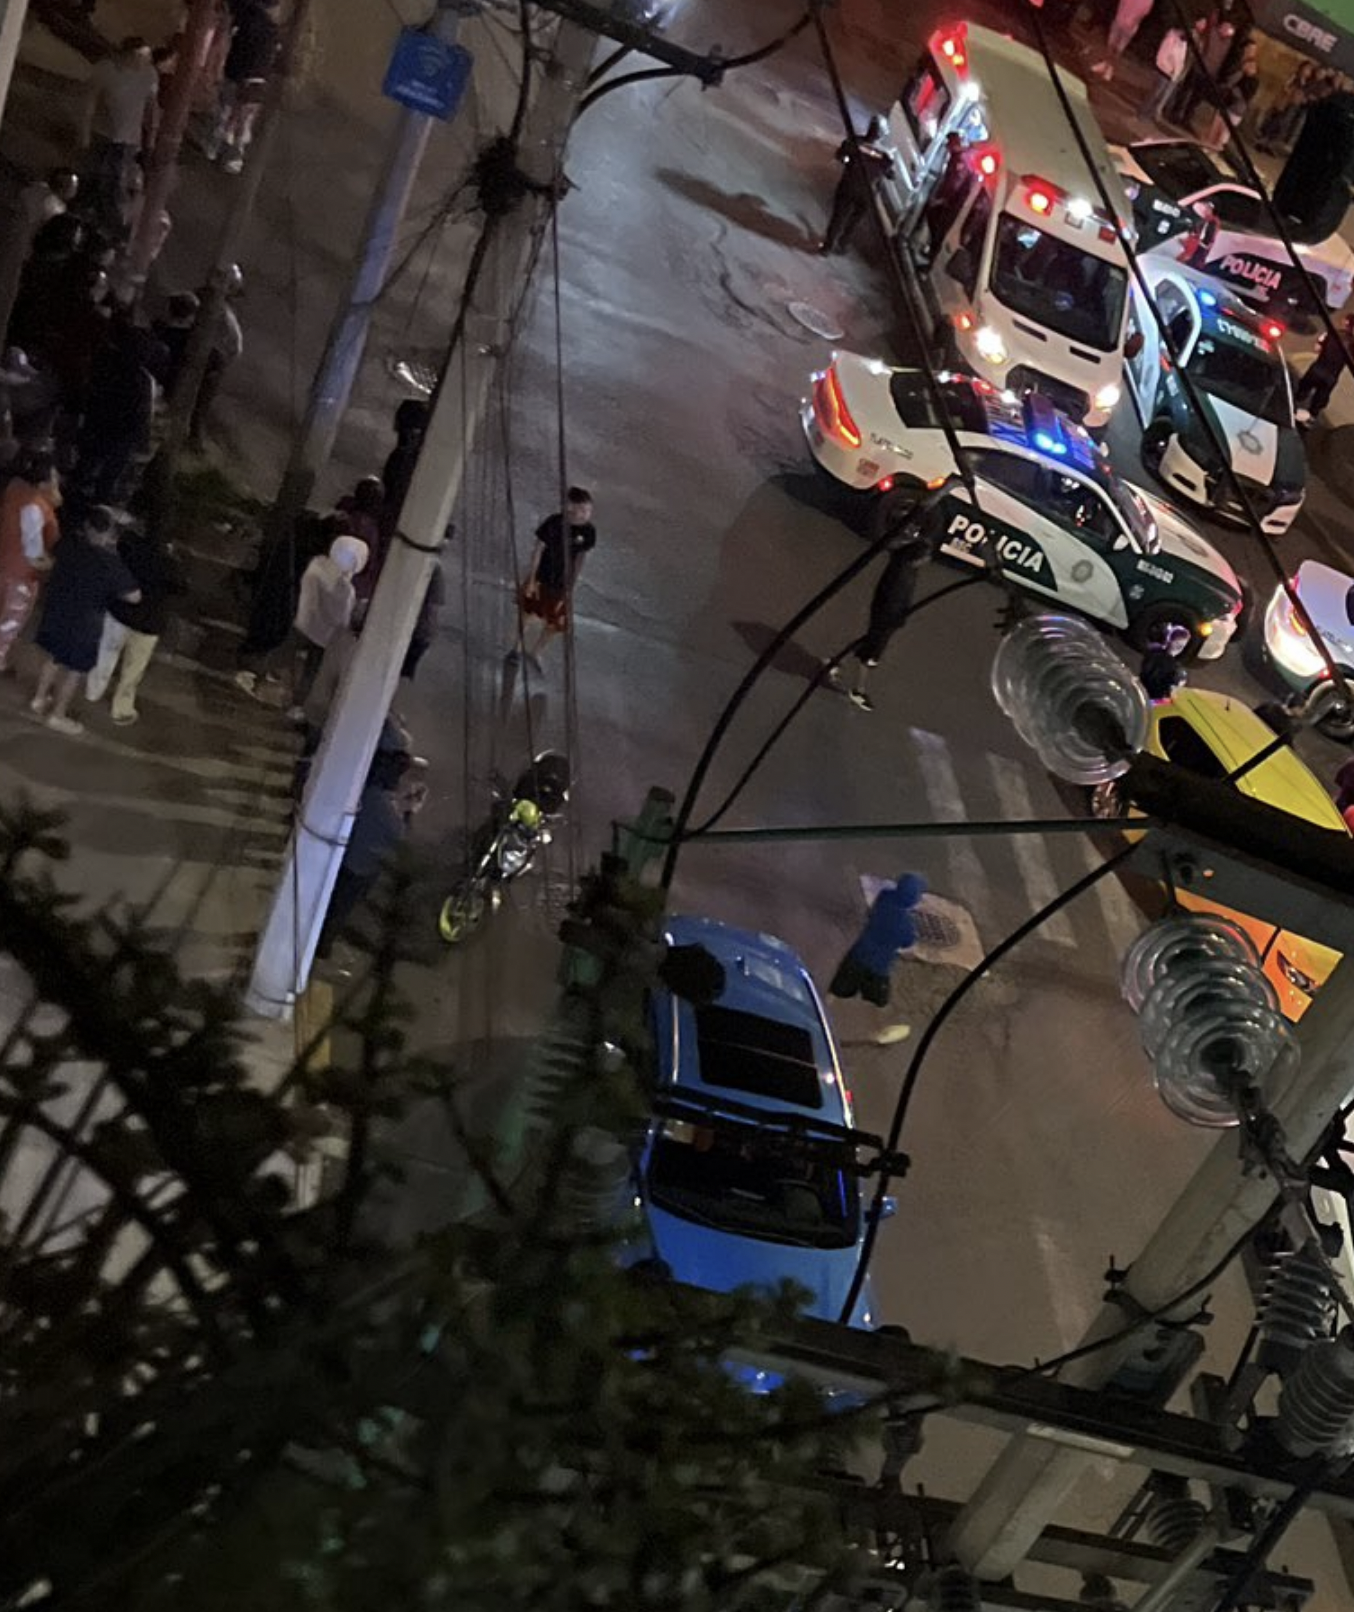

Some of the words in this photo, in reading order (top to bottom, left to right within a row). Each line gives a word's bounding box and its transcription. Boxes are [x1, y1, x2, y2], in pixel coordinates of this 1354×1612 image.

[1283, 14, 1338, 53] CBRE
[1220, 255, 1281, 290] POLICIA
[947, 514, 1044, 572] POICIA
